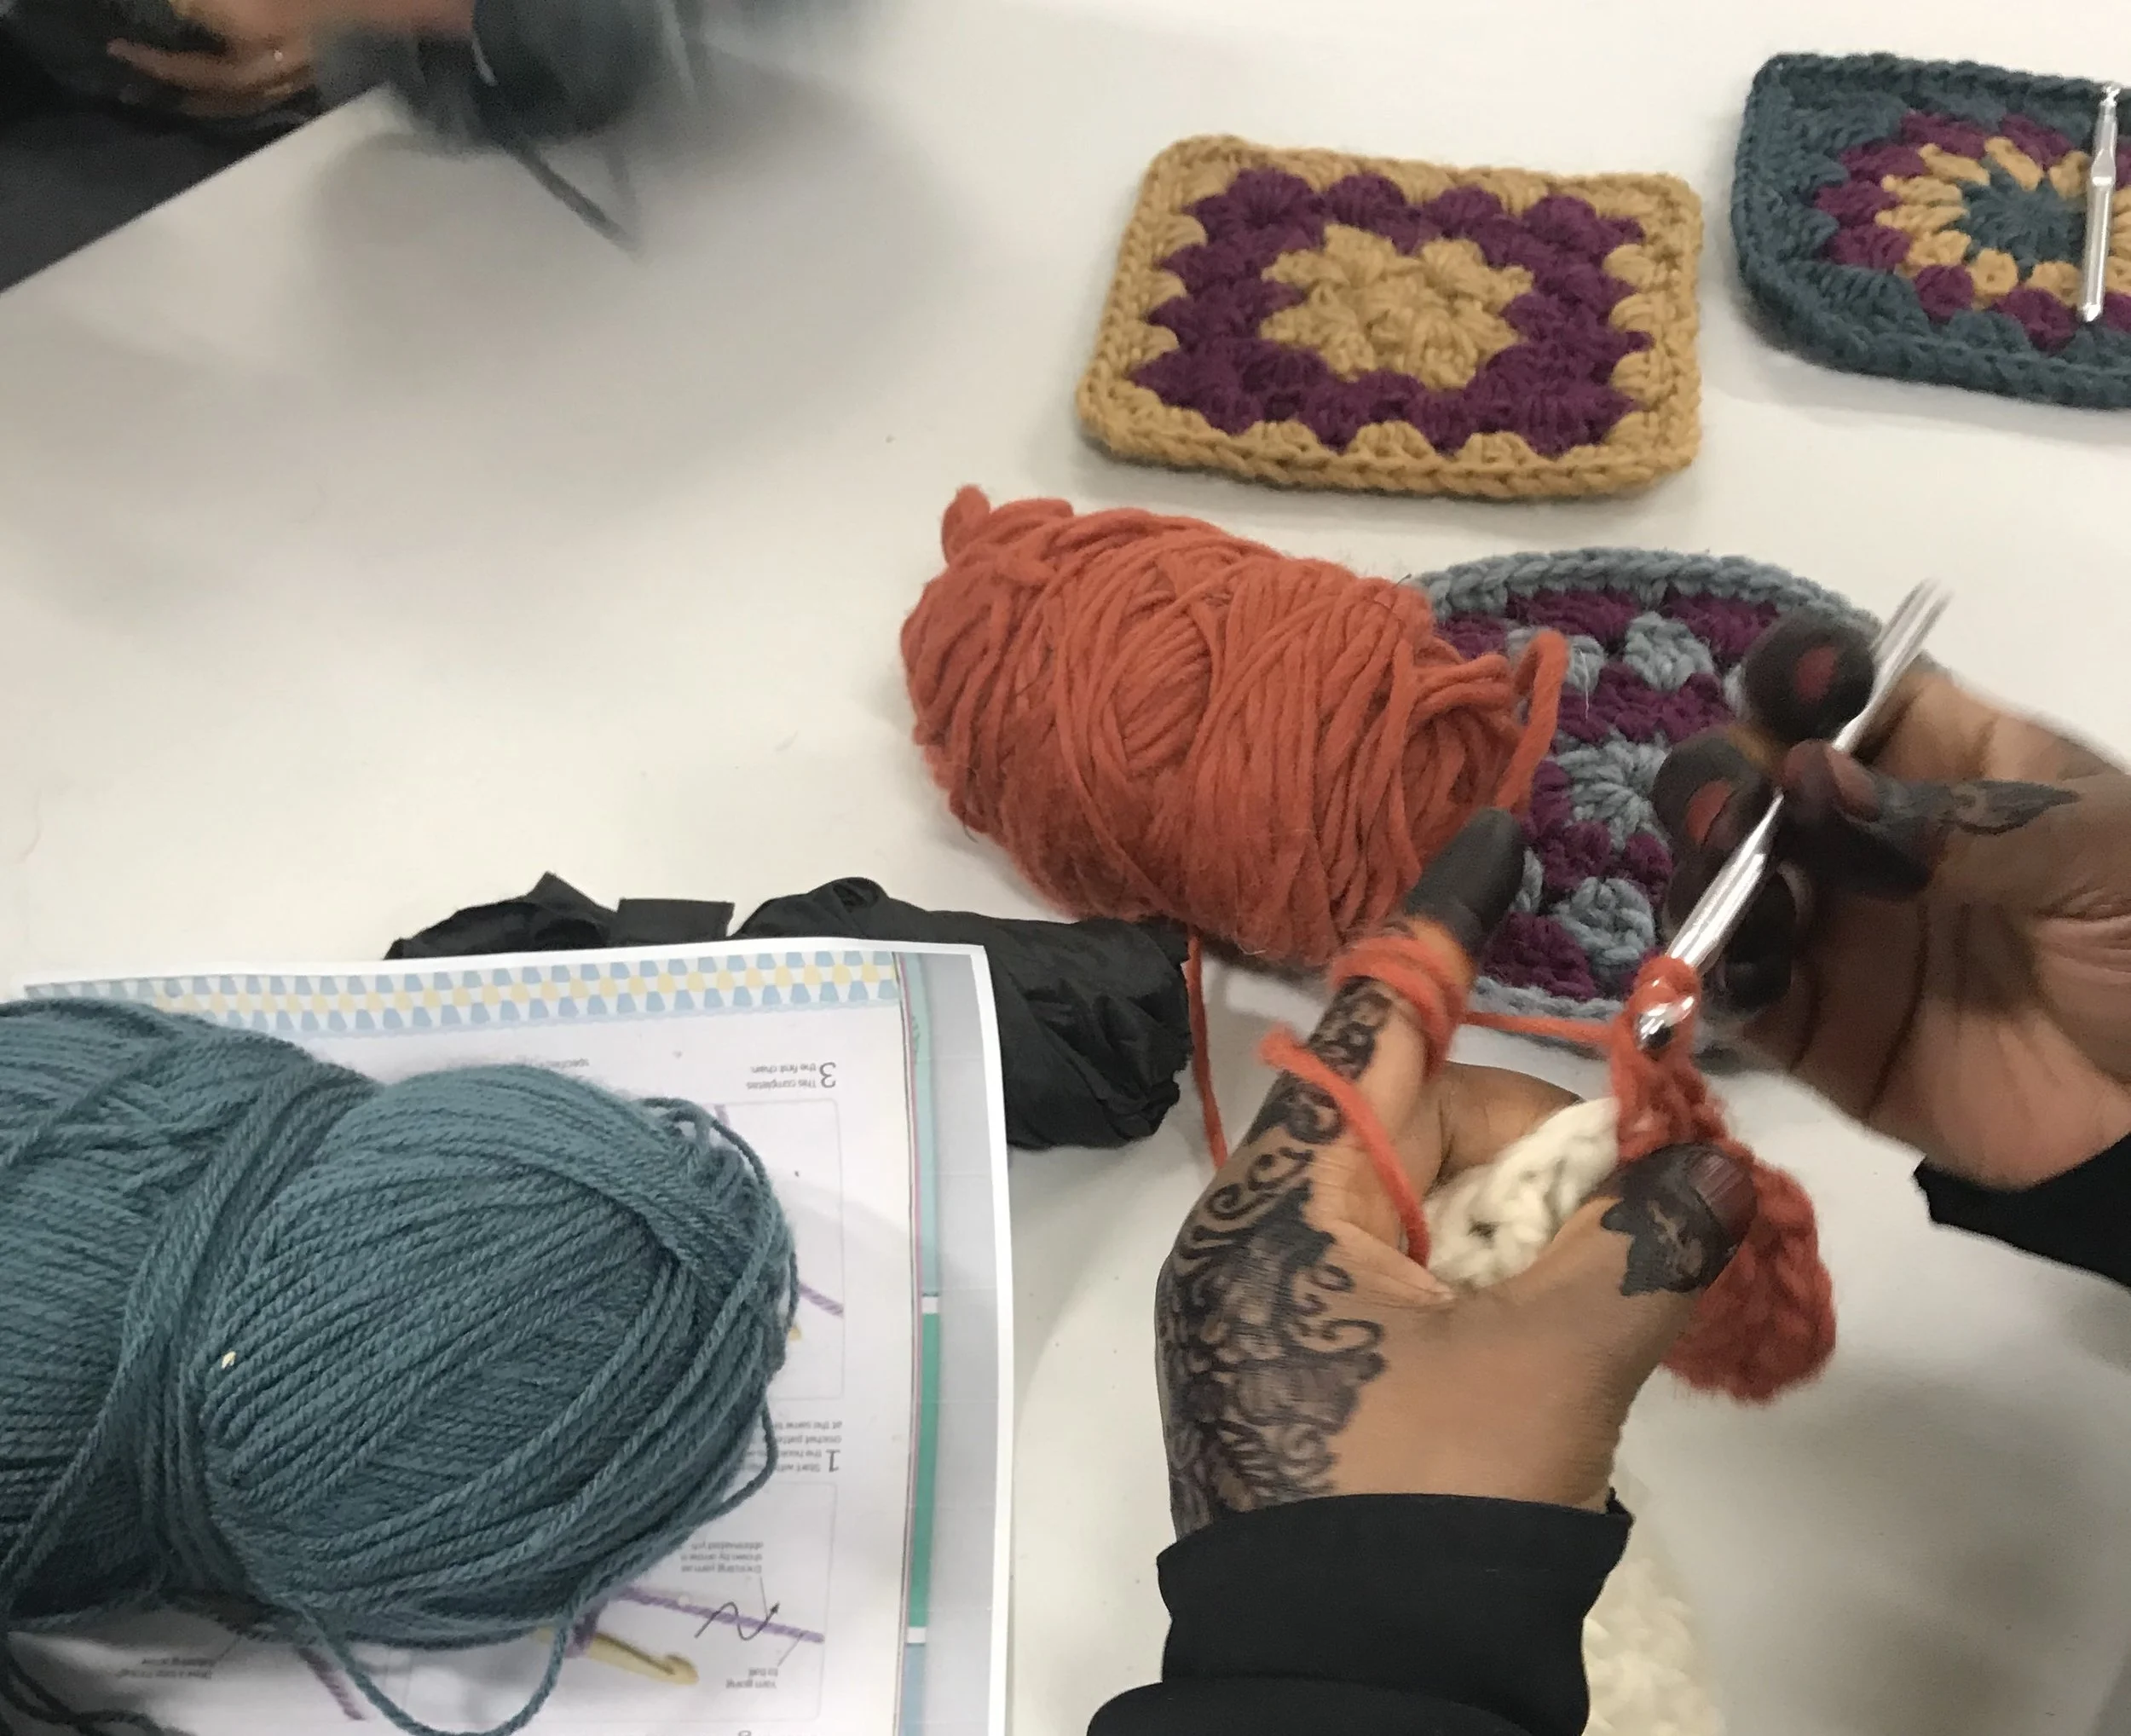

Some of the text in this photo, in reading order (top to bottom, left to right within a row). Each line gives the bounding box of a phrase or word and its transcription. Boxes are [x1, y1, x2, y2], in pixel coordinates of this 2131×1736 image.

[781, 1064, 798, 1074] first
[820, 1062, 836, 1088] 3
[747, 1079, 817, 1090] This completes
[826, 1450, 840, 1473] 1
